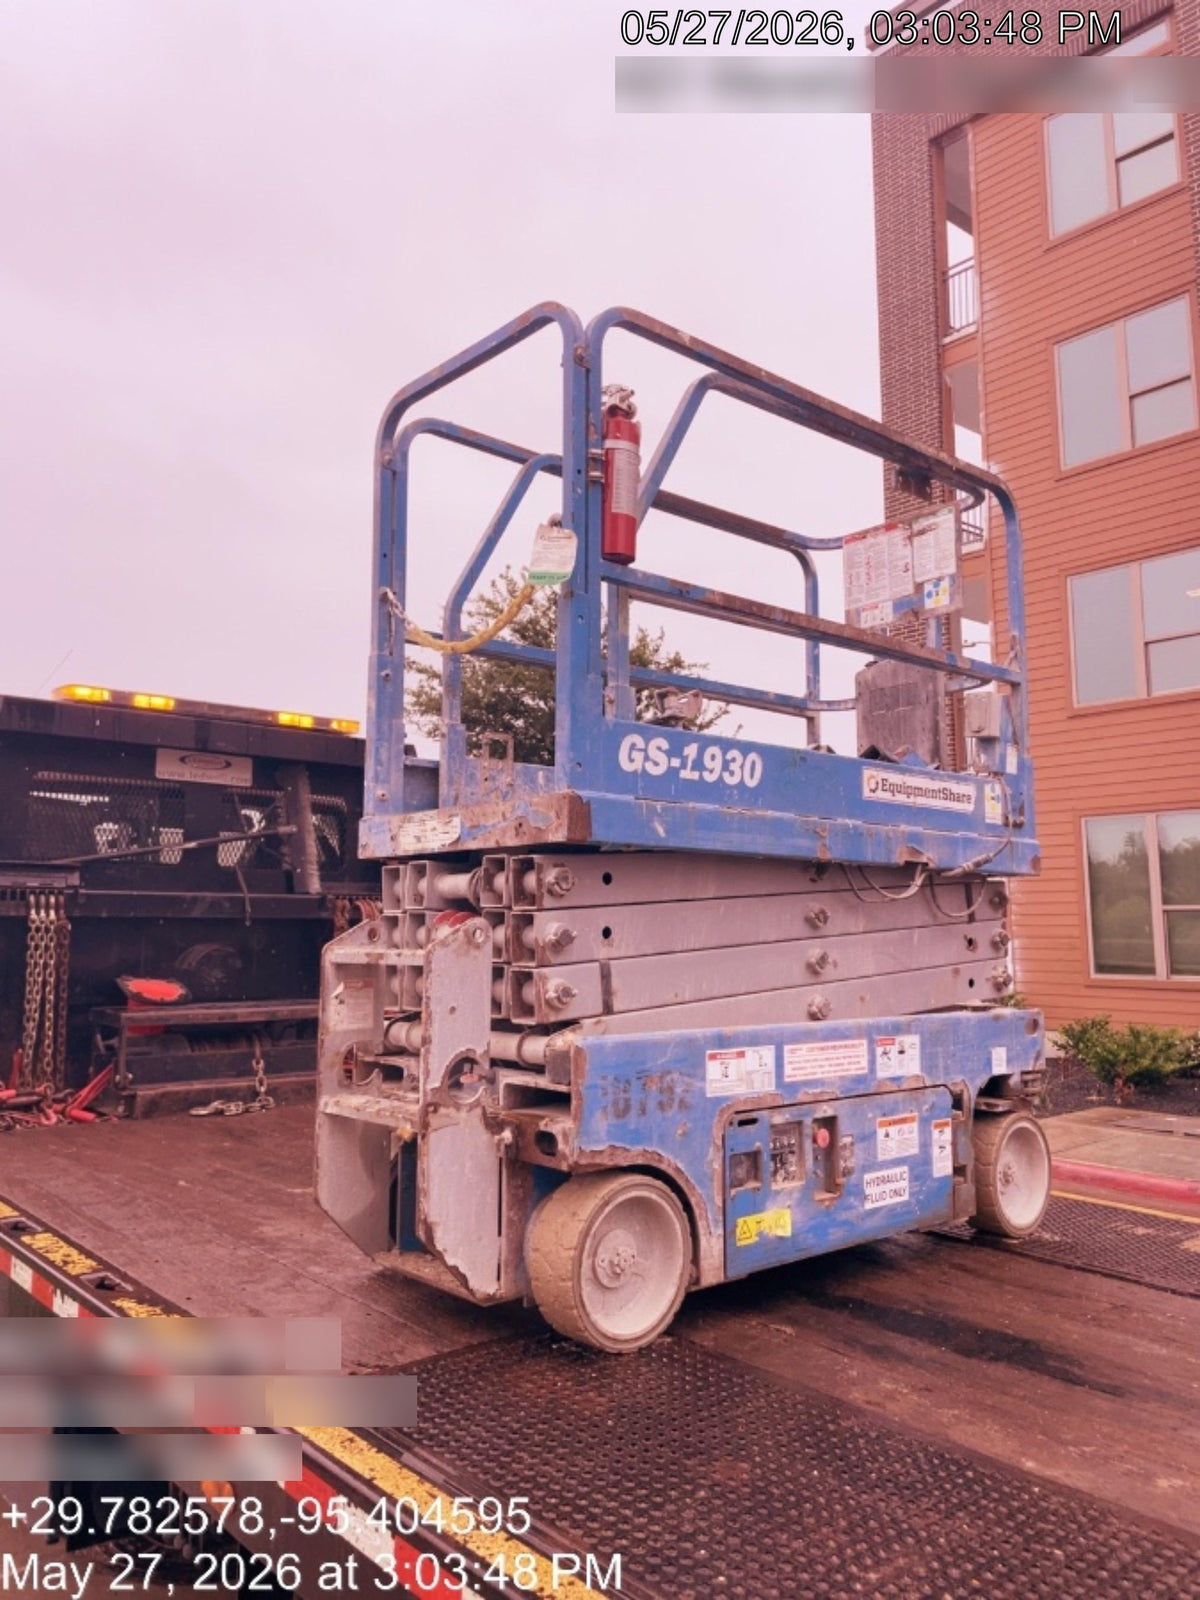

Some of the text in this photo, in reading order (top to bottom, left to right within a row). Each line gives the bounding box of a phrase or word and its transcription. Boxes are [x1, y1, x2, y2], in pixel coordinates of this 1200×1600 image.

[618, 733, 763, 788] GS-1930
[881, 778, 972, 804] EquipmentShare
[866, 1171, 907, 1188] HYDRAULIC
[864, 1187, 906, 1204] FLUID ONLY
